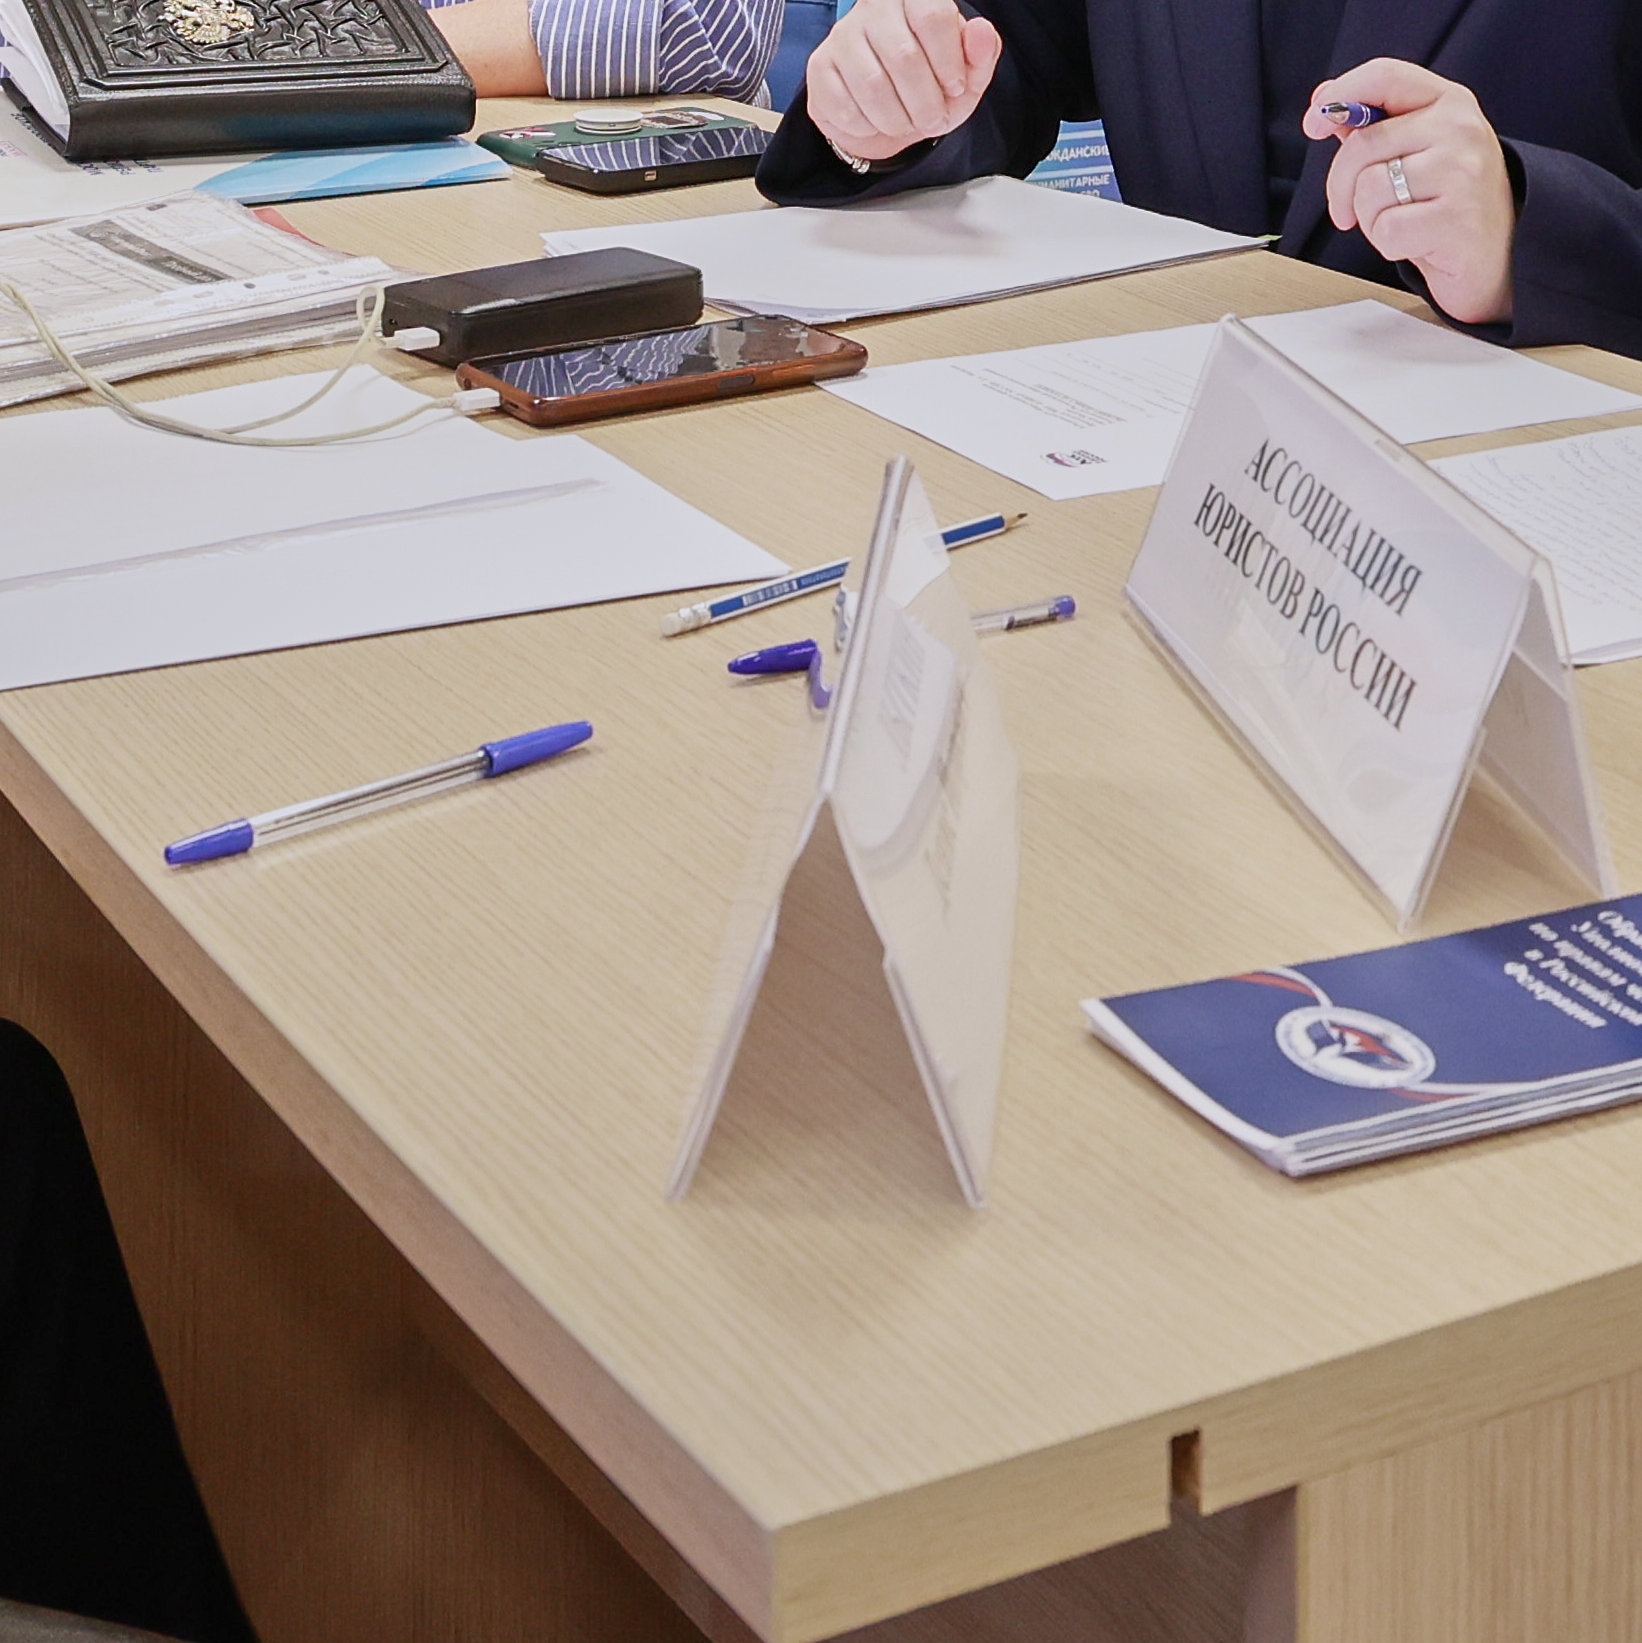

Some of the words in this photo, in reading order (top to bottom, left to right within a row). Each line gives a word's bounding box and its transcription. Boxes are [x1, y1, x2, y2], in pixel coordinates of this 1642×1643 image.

[1193, 483, 1306, 620] ЮРИСТОВ
[1299, 587, 1418, 731] РОССИИ
[1244, 436, 1423, 618] АССОЦИАЦИЯ
